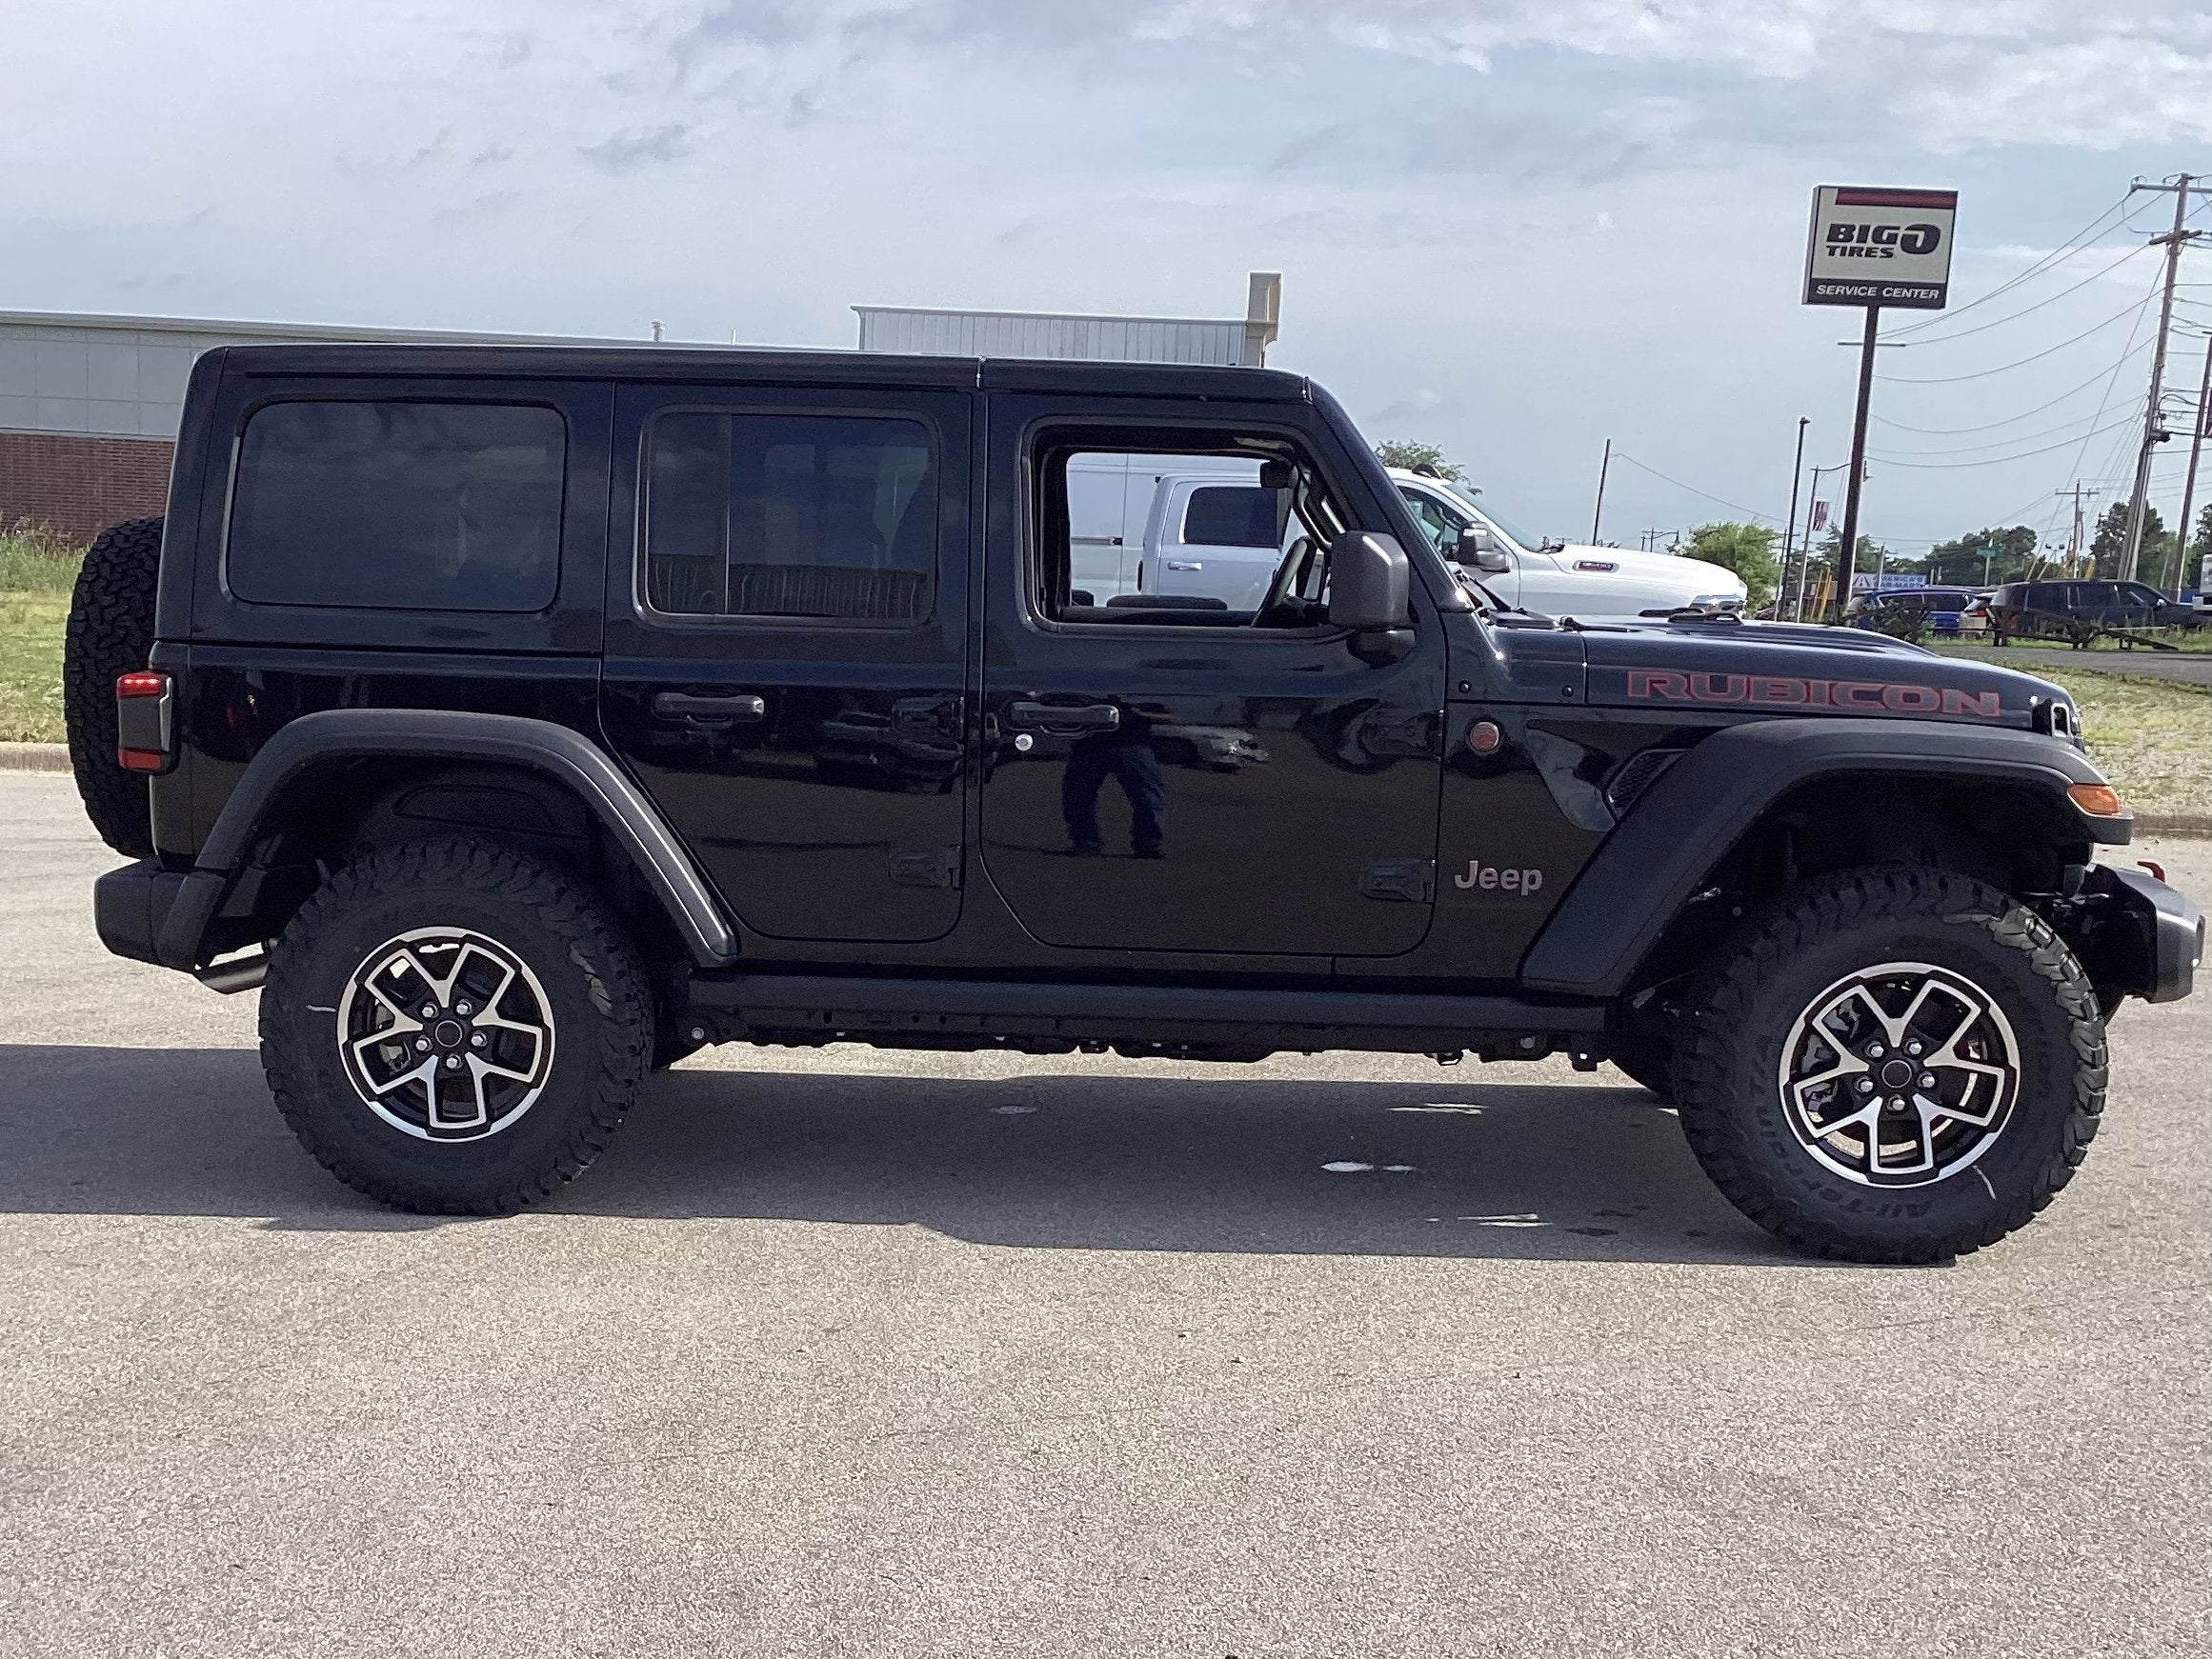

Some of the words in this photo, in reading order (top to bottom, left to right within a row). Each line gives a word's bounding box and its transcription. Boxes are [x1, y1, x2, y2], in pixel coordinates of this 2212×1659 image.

[1826, 223, 1900, 246] BIG
[1900, 224, 1941, 254] O
[1826, 245, 1895, 258] TIRES
[1816, 285, 1878, 297] SERVICE
[1882, 287, 1939, 299] CENTER
[1627, 670, 2001, 716] RUBICON
[1454, 860, 1542, 896] Jeep
